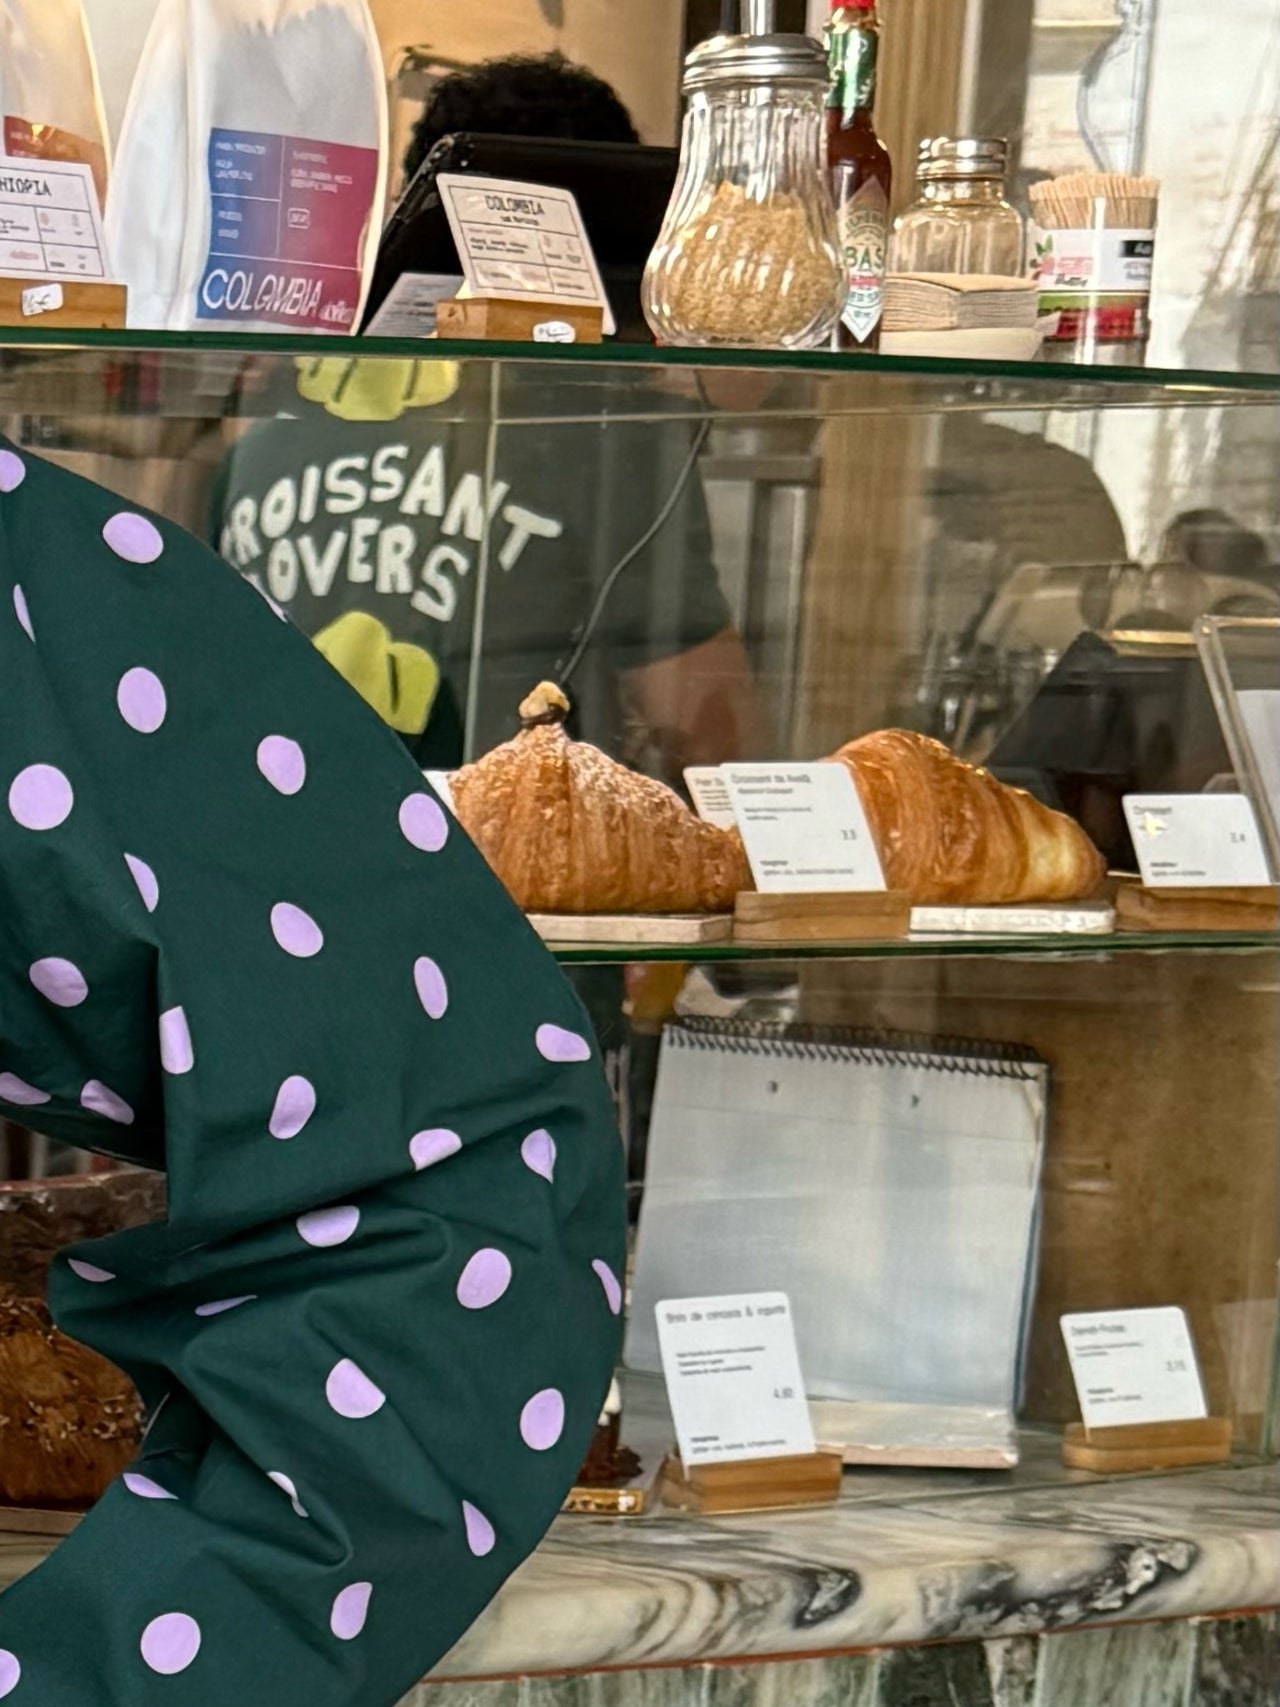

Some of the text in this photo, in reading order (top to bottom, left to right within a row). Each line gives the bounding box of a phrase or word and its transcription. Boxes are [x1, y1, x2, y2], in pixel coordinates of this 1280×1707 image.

[485, 194, 546, 216] COLOMBIA
[202, 268, 323, 316] COLOMBIA
[246, 518, 470, 622] OVERS
